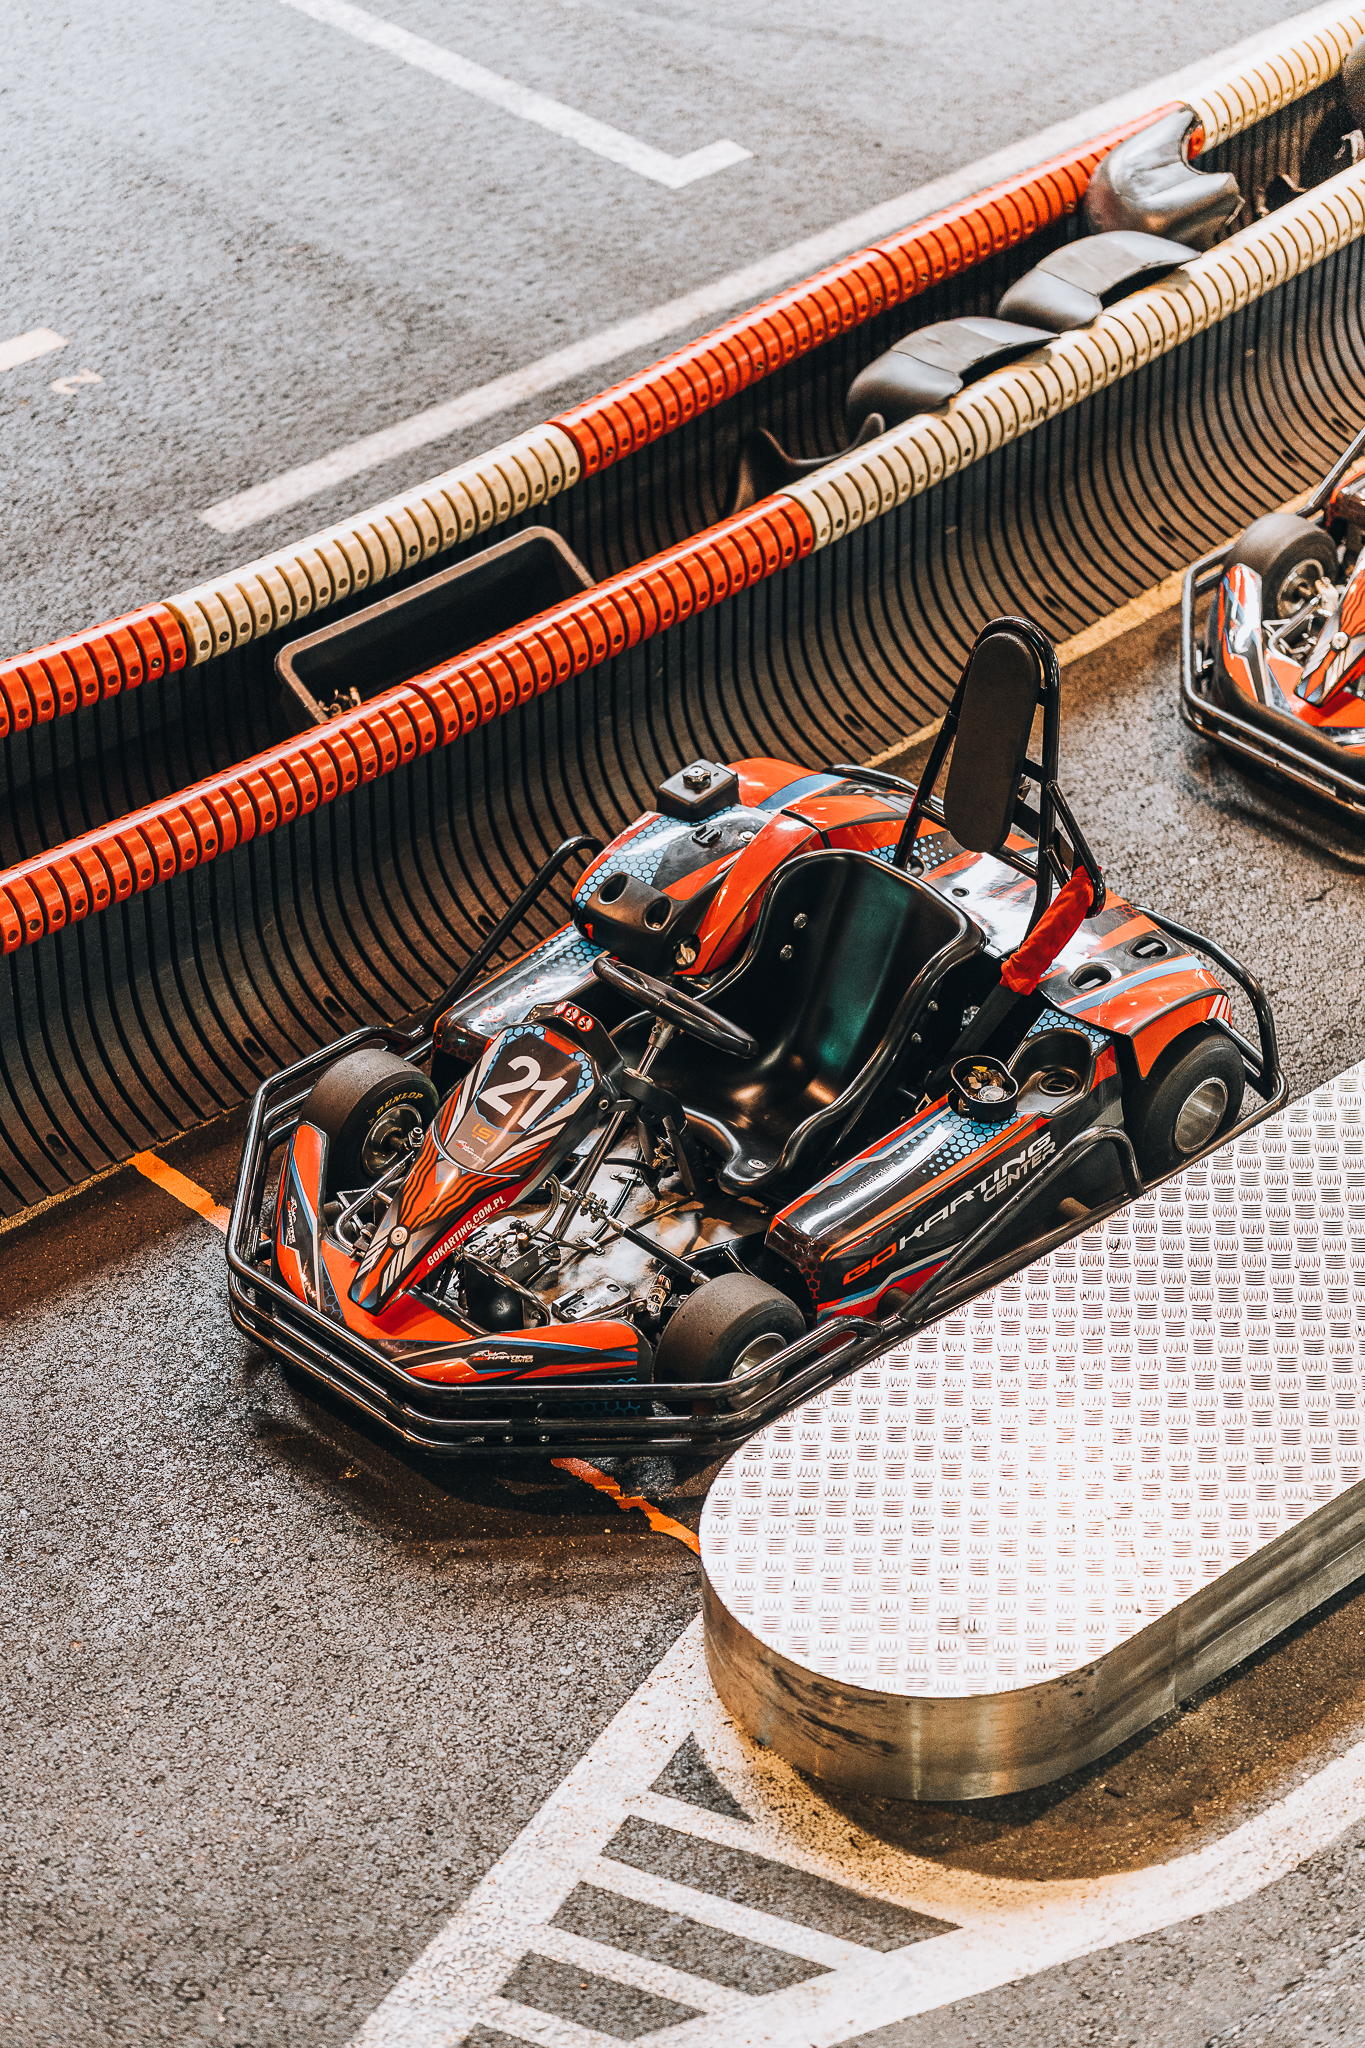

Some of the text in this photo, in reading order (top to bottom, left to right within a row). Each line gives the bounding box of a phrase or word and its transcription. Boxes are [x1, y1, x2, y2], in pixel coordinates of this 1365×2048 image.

[376, 1091, 424, 1117] DUNLOP
[478, 1055, 568, 1131] 21
[983, 1140, 1057, 1203] CENTER
[426, 1195, 507, 1267] GOKARTING.COM.PL
